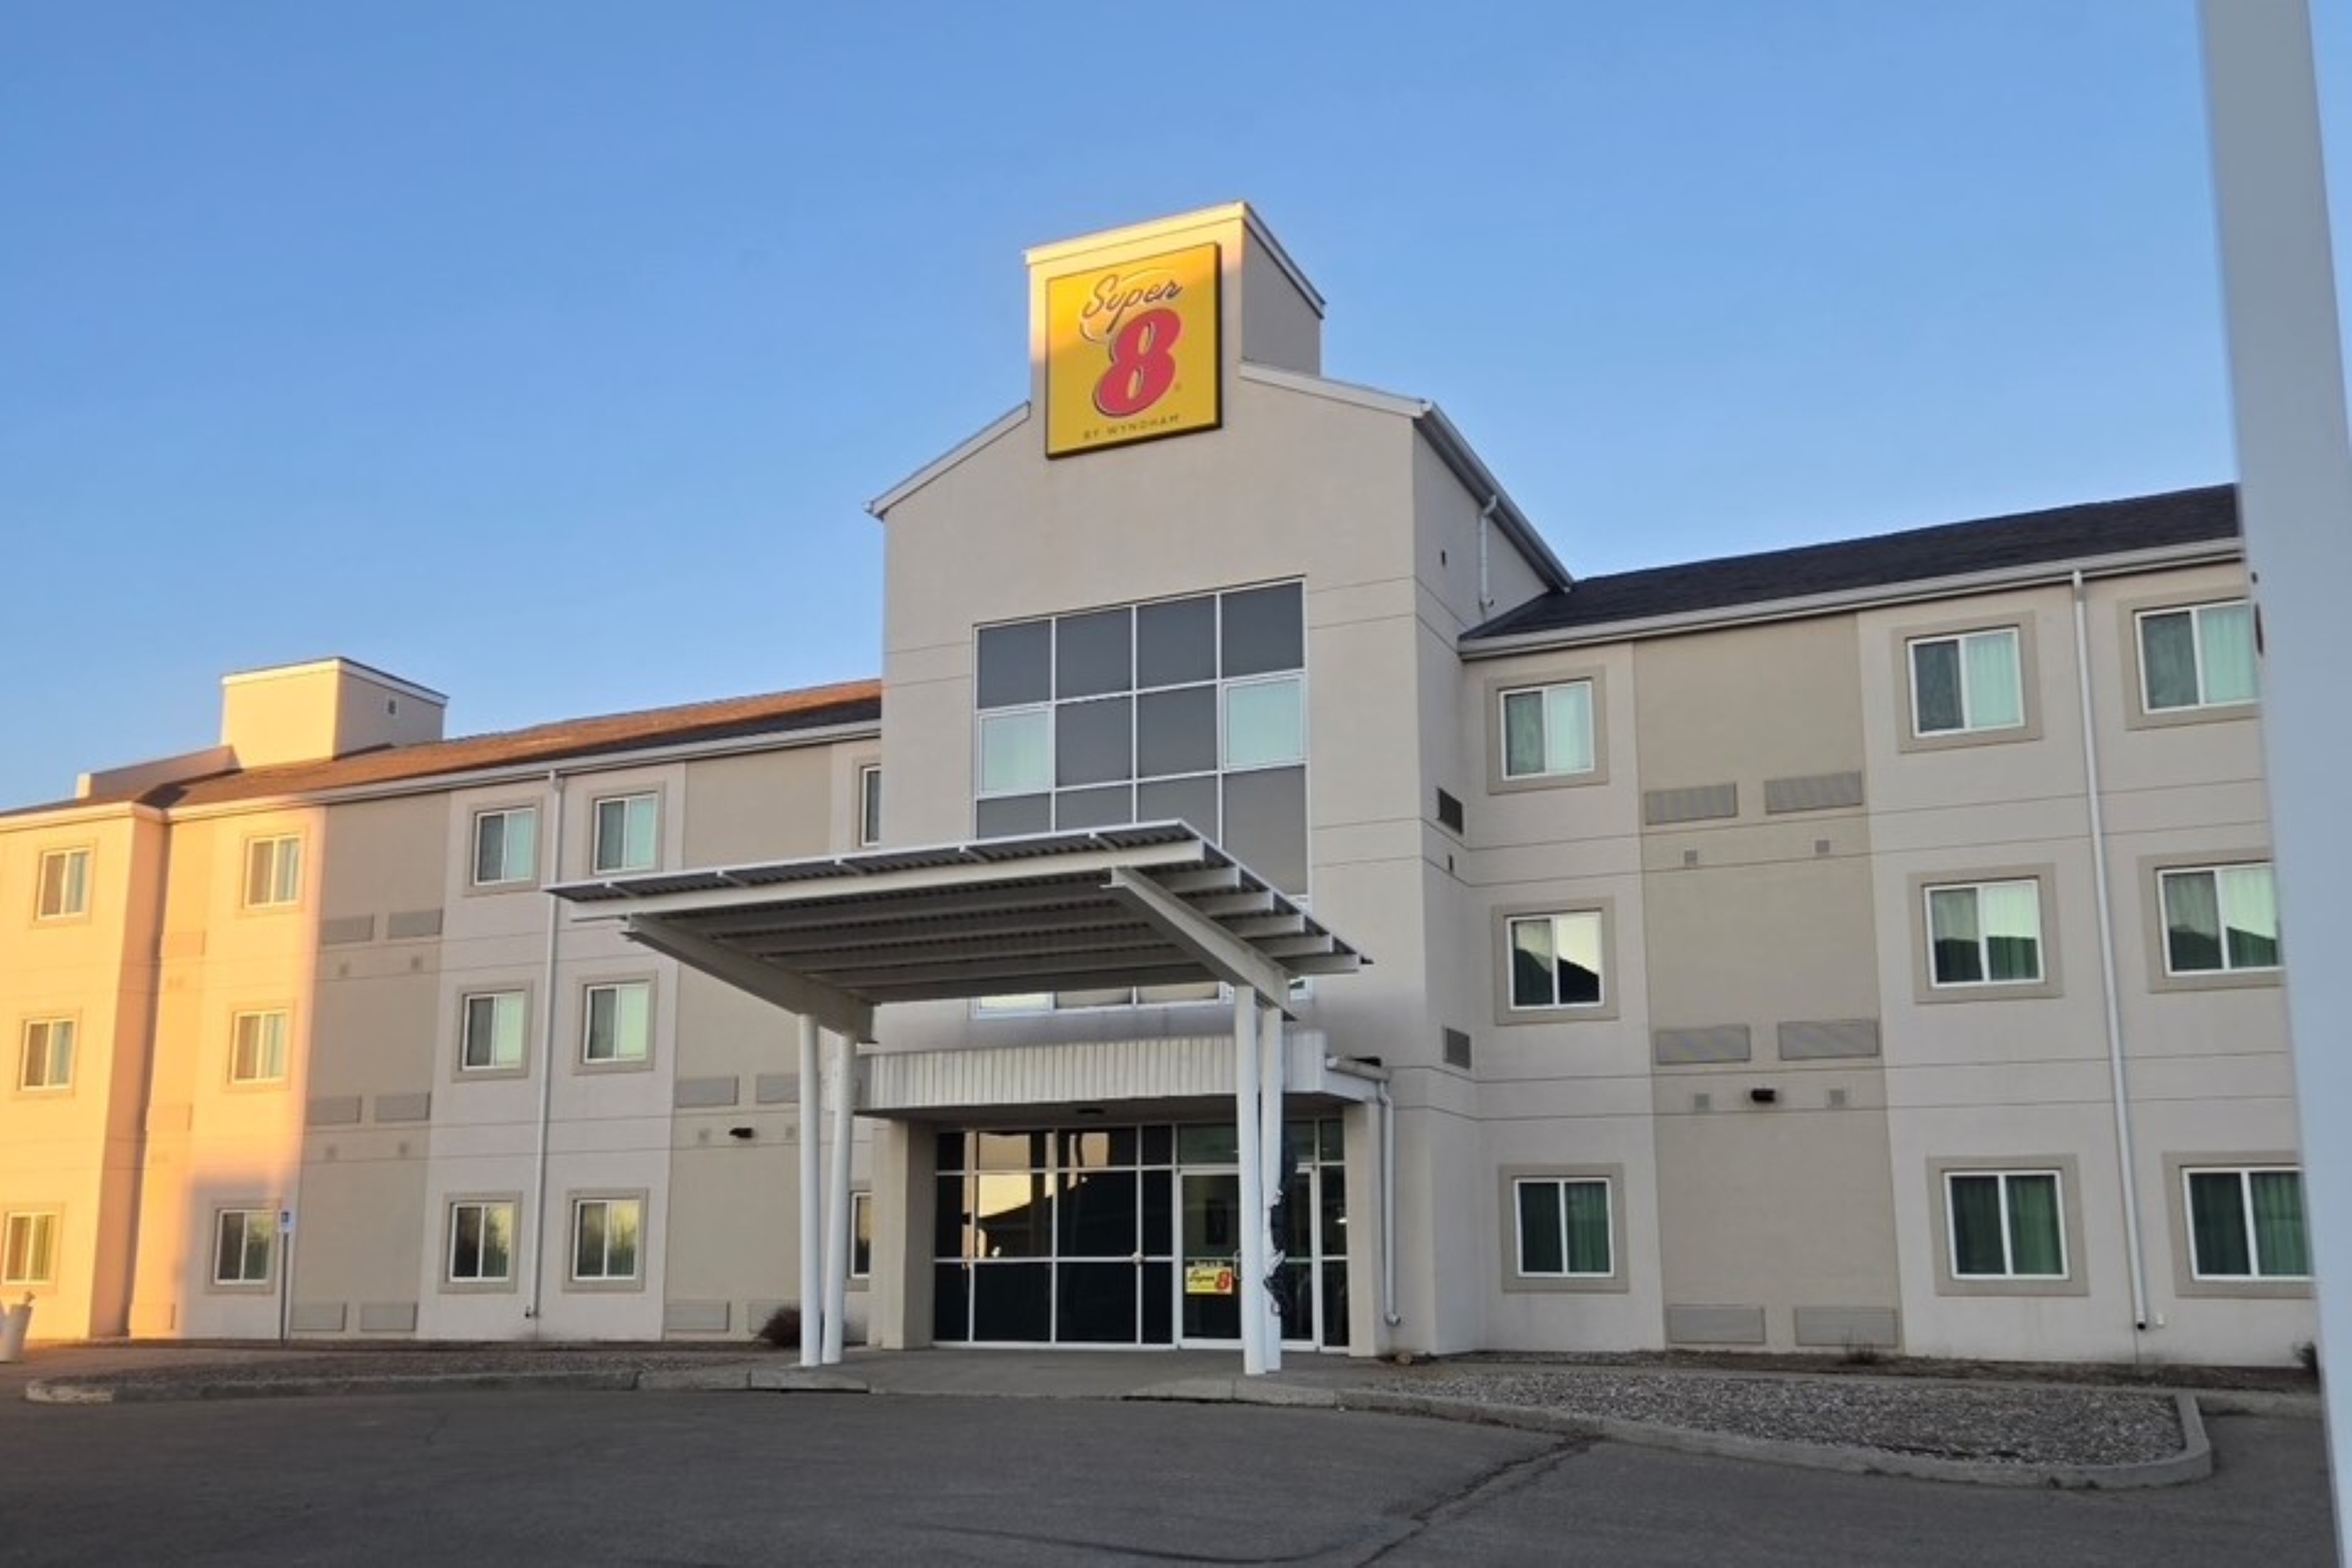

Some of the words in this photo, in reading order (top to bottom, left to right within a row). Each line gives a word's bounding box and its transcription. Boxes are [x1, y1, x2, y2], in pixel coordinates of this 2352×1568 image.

[1081, 274, 1182, 334] Super
[1093, 308, 1181, 418] 8
[1215, 1270, 1230, 1290] 8
